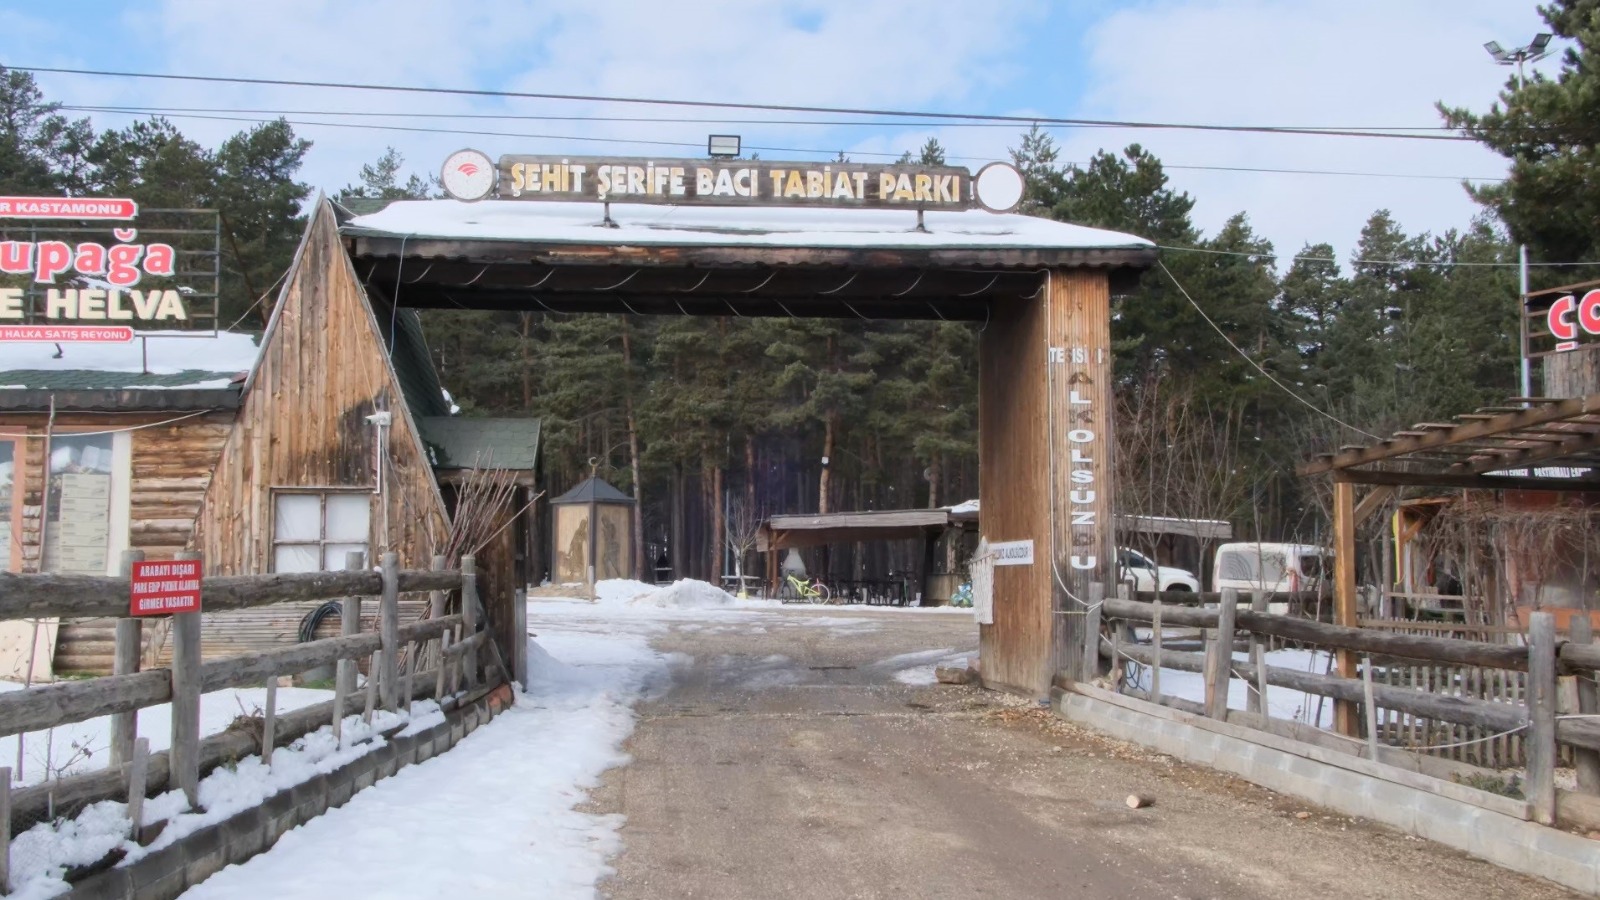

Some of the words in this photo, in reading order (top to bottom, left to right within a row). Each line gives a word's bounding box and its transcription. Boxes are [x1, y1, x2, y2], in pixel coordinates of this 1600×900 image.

[511, 159, 586, 197] ŞEHİT
[597, 161, 686, 200] ŞERİFE
[696, 168, 758, 196] BACI
[769, 166, 869, 199] TABİAT
[879, 172, 960, 202] PARKI
[16, 202, 122, 214] KASTAMONU
[47, 288, 187, 320] HELVA
[5, 330, 42, 339] HALKA
[45, 330, 79, 340] SATIŞ
[81, 331, 127, 339] REYONU
[140, 565, 170, 577] ARABAYI
[172, 564, 195, 578] DIŞARI
[133, 582, 147, 593] PARK
[139, 598, 164, 610] GİRMEK
[165, 596, 194, 608] YASAKTIR
